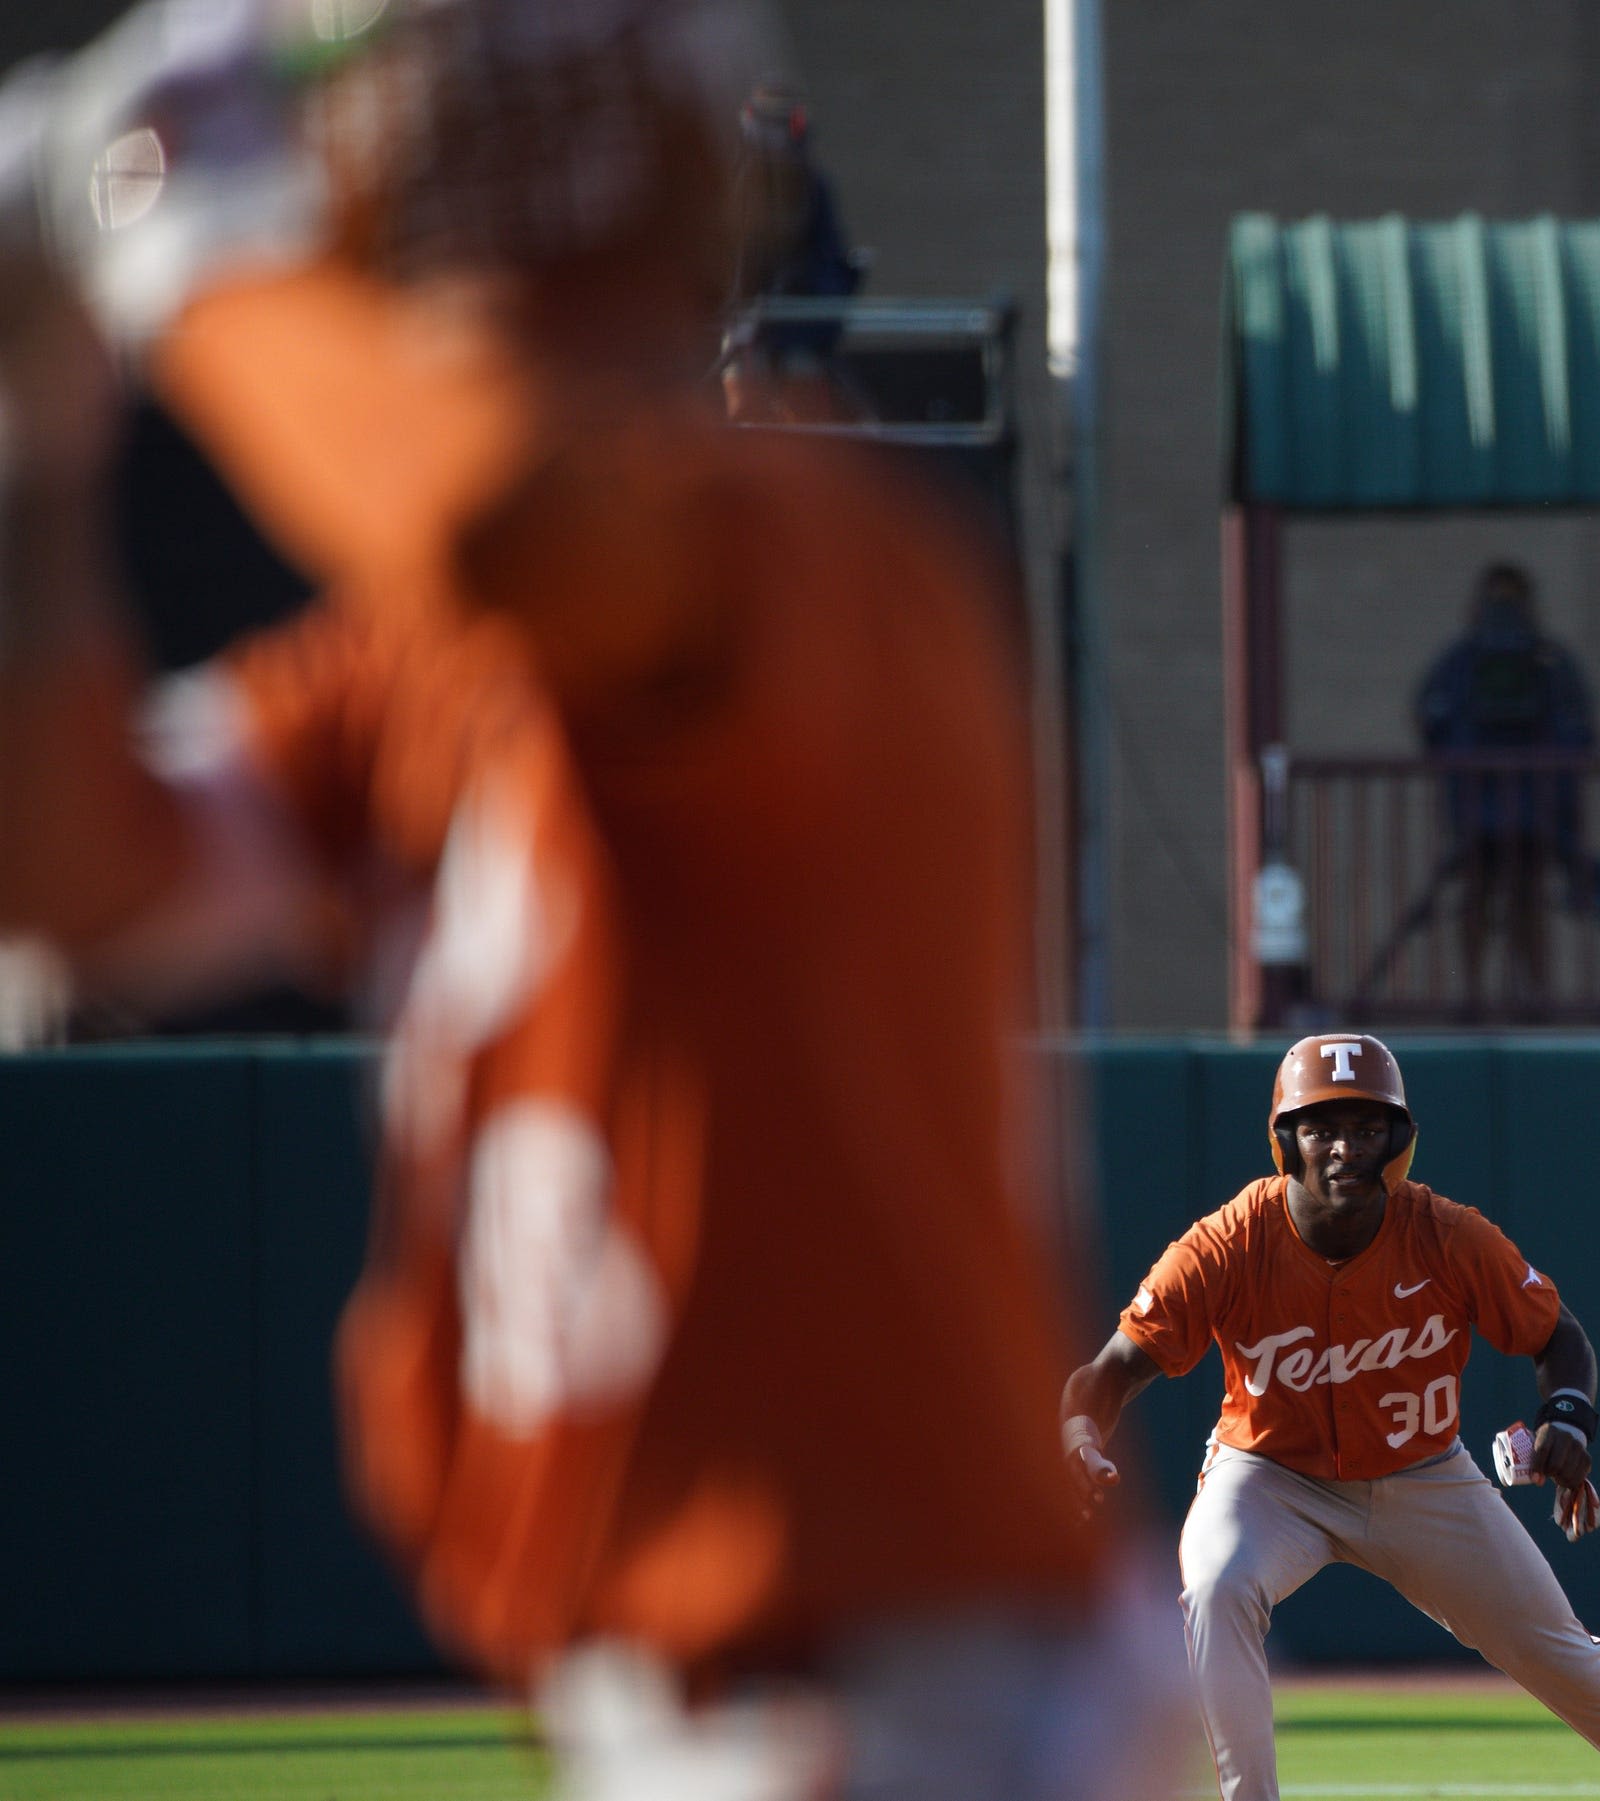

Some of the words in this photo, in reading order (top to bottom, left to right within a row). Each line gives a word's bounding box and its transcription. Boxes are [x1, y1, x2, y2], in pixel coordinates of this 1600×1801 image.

[1320, 1043, 1362, 1082] T
[1235, 1314, 1459, 1397] Texas
[1379, 1374, 1457, 1449] 30
